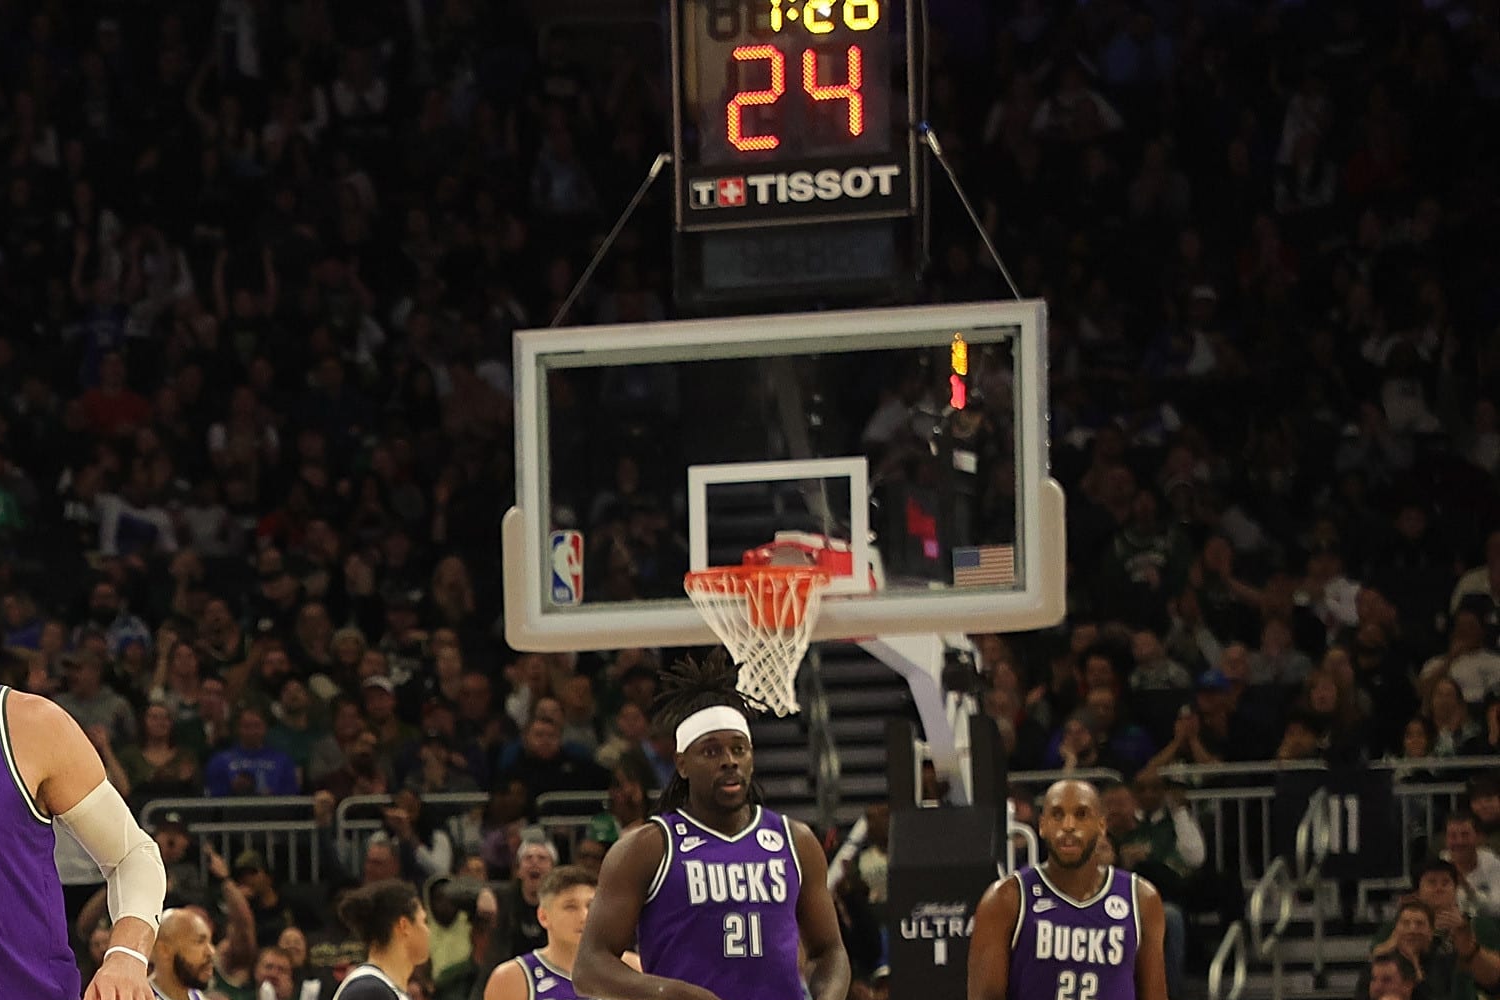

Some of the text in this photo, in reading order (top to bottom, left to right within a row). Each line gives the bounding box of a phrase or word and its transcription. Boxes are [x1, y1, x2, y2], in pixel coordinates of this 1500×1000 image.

[727, 44, 863, 151] 24
[747, 165, 900, 205] TISSOT
[682, 858, 788, 905] BUCKS
[723, 911, 764, 958] 21
[1034, 919, 1126, 966] BUCKS
